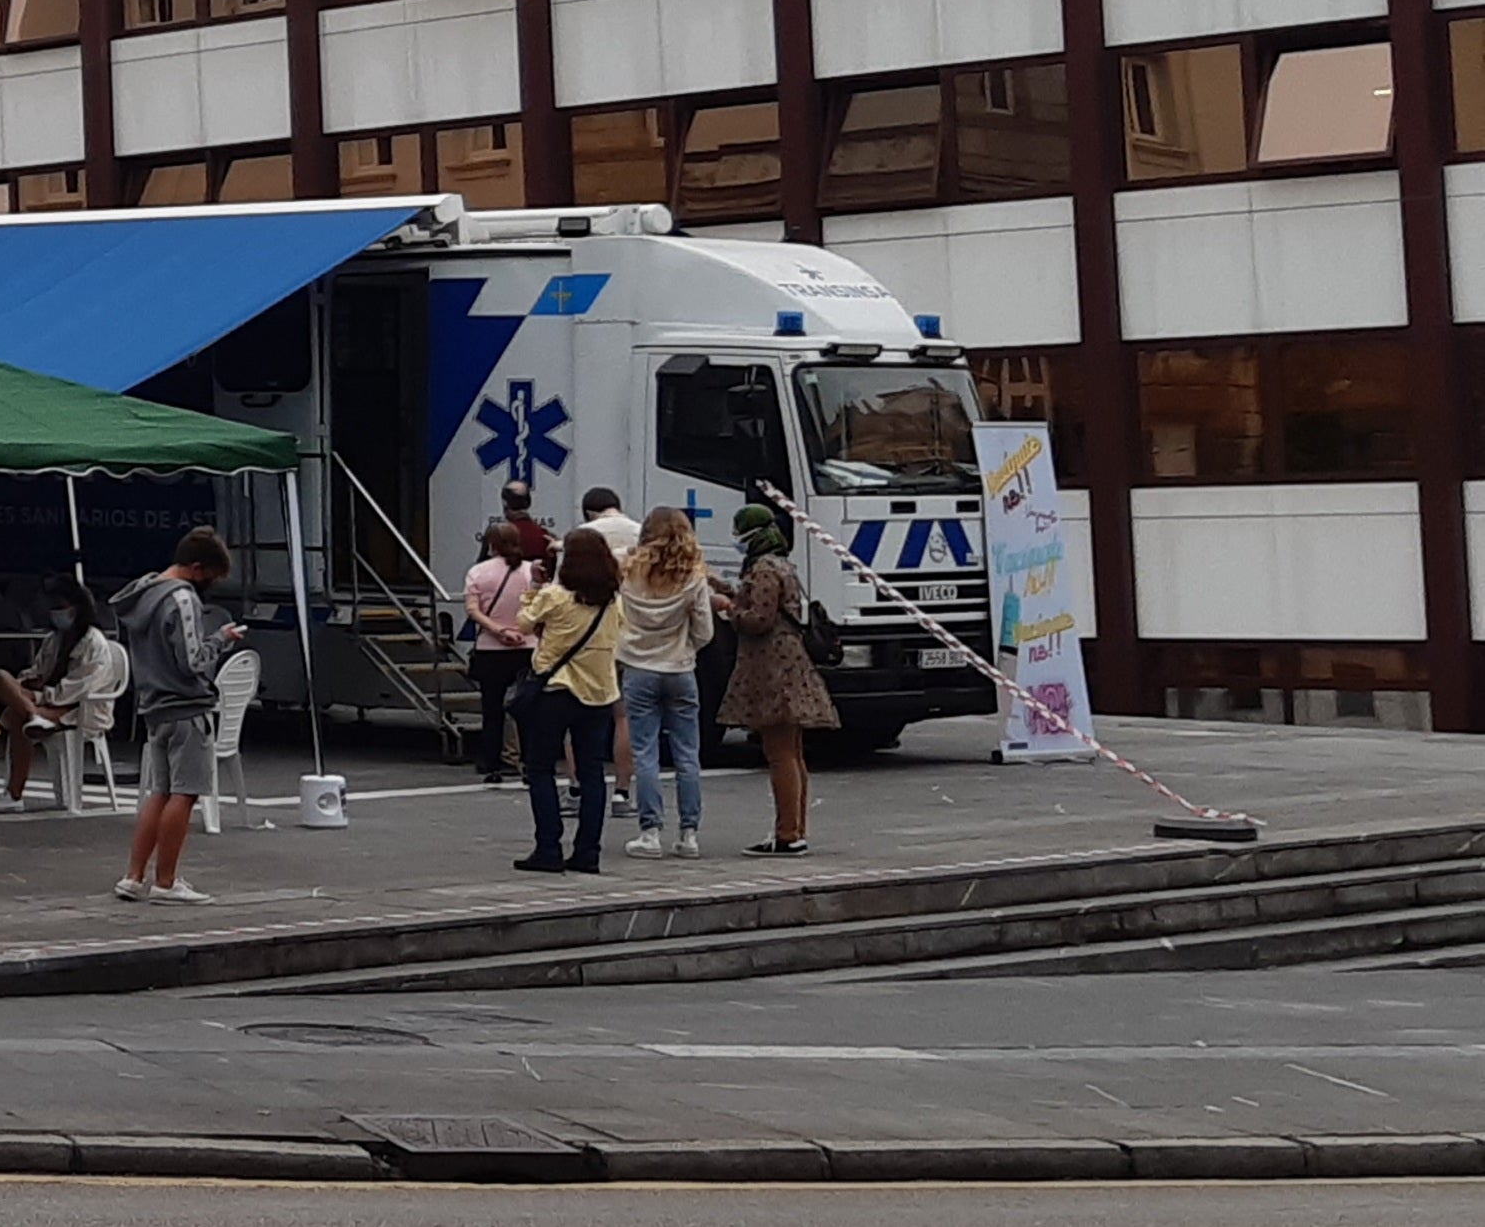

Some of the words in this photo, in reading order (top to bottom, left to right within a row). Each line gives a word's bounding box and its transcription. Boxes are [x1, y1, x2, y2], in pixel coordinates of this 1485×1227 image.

[21, 507, 137, 528] SANIARIOS
[144, 509, 172, 529] DE
[177, 510, 217, 529] AST
[919, 585, 958, 600] IVECO
